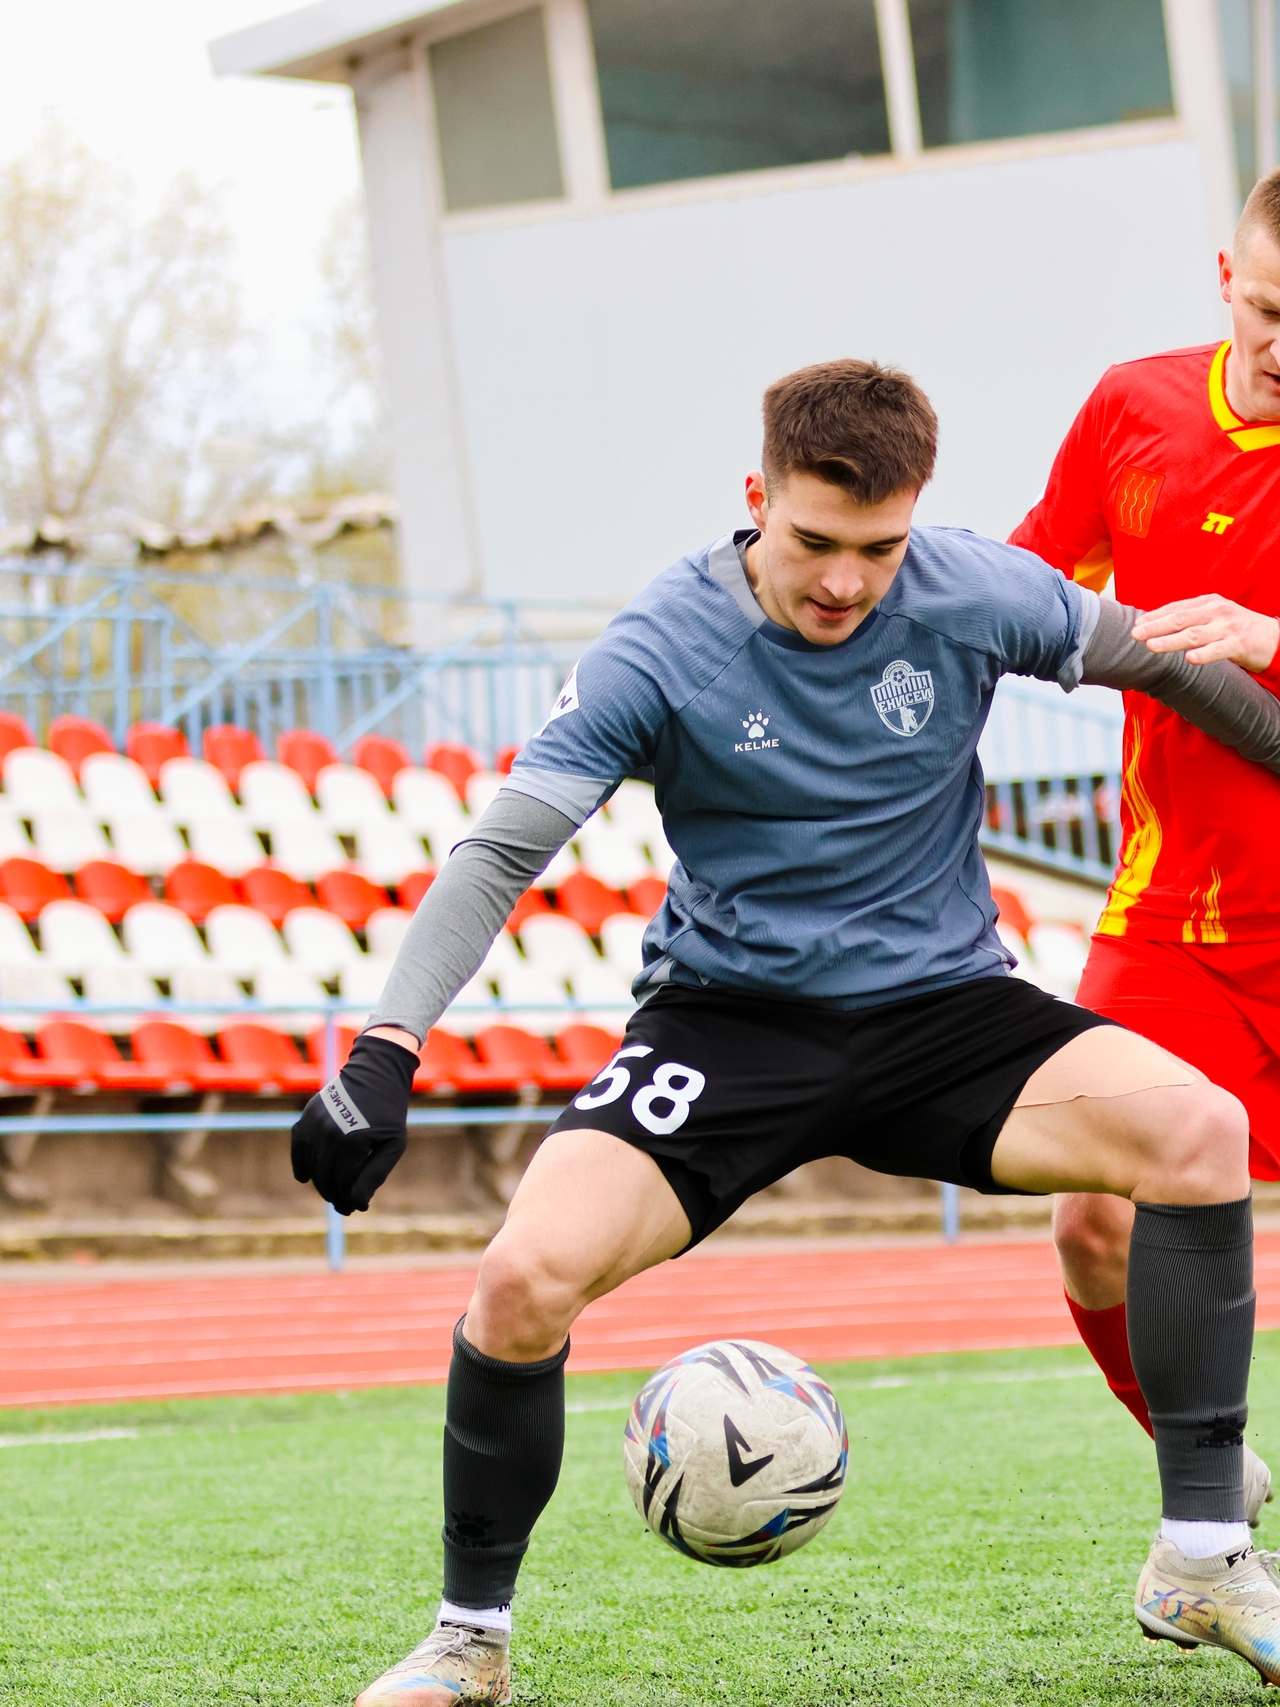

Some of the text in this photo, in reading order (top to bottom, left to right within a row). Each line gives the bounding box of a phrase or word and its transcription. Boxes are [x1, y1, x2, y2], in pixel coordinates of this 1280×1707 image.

[877, 685, 934, 714] ЕНИСЕЙ
[734, 738, 780, 753] KELME
[574, 1045, 706, 1135] 58
[330, 1091, 359, 1128] KELME
[446, 1526, 497, 1549] KELME
